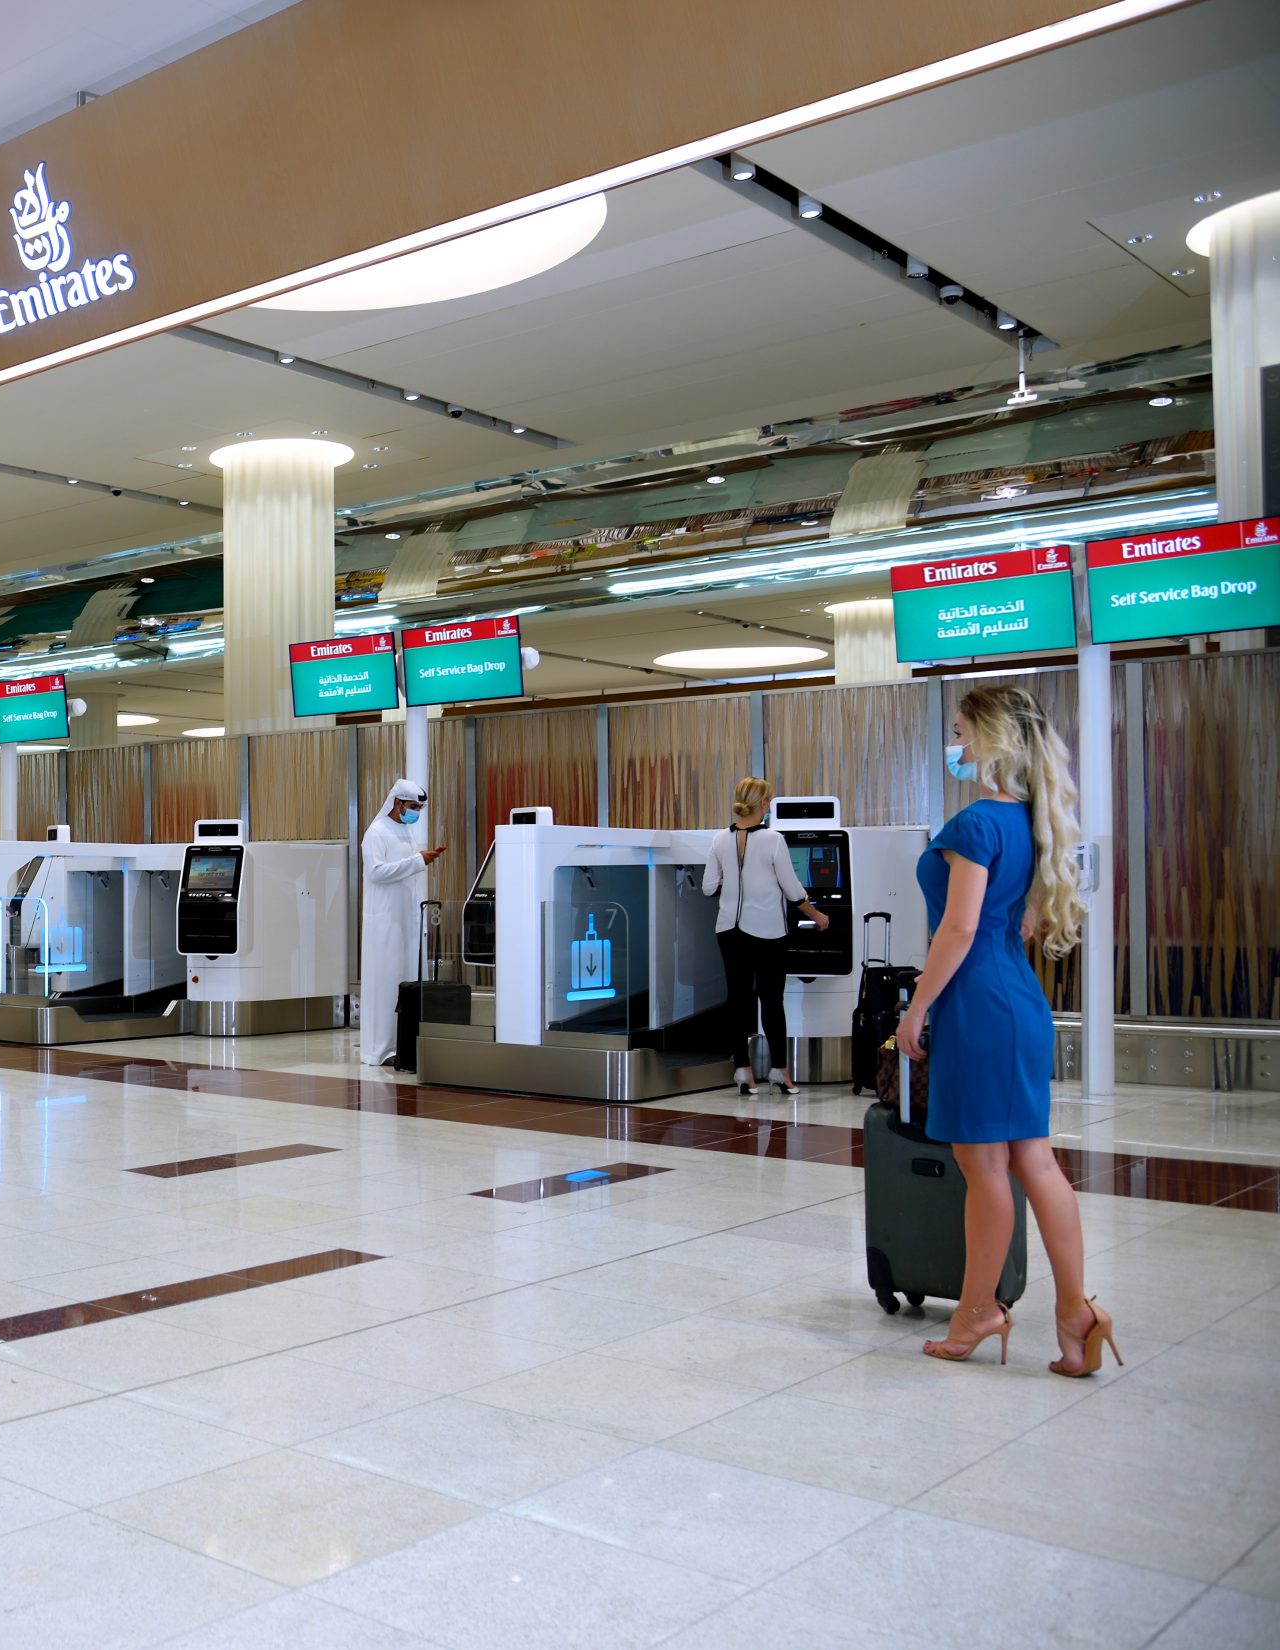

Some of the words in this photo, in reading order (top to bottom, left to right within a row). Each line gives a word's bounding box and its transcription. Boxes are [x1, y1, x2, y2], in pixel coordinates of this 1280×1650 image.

[1121, 536, 1202, 559] Emirates
[1245, 534, 1278, 545] Emirates
[923, 561, 997, 583] Emirates
[1110, 592, 1137, 608] Self
[1138, 588, 1189, 605] Service
[1190, 585, 1219, 599] Bag
[1220, 580, 1257, 595] Drop
[937, 605, 978, 623] الذاتية
[979, 600, 1025, 616] الخدمة
[425, 627, 472, 643] Emirates
[937, 622, 981, 639] الأمتعة
[982, 618, 1029, 639] لتسليم
[310, 643, 353, 657] Emirates
[419, 667, 436, 678] Self
[436, 665, 466, 677] Service
[467, 663, 484, 674] Bag
[484, 661, 506, 672] Drop
[6, 683, 36, 695] Emirates
[605, 908, 617, 929] 7
